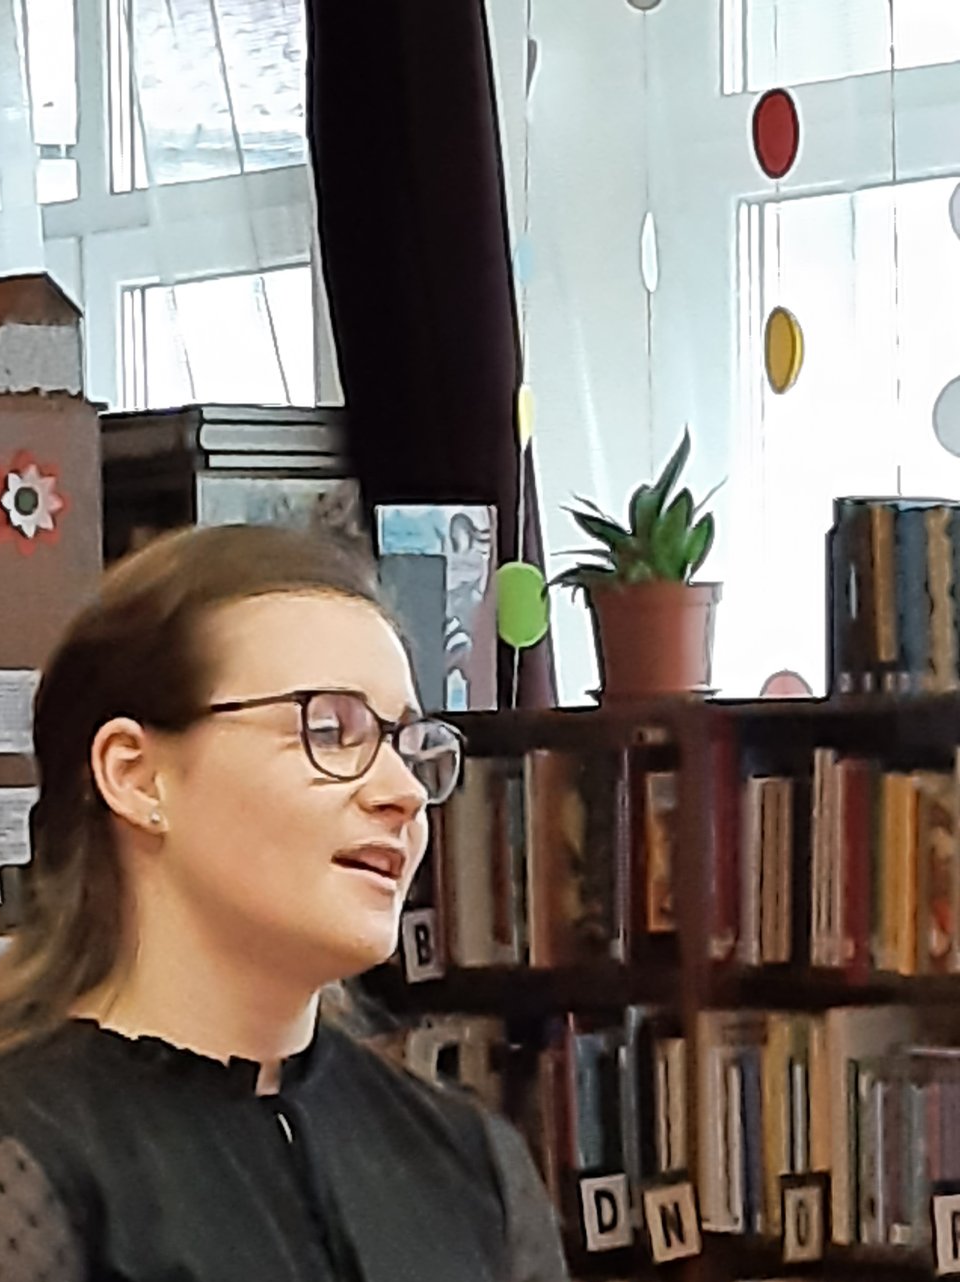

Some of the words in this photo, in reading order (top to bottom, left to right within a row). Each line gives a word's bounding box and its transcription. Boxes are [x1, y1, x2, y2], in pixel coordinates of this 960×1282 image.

[415, 922, 433, 968] B
[594, 1189, 618, 1234] D
[660, 1201, 685, 1248] N
